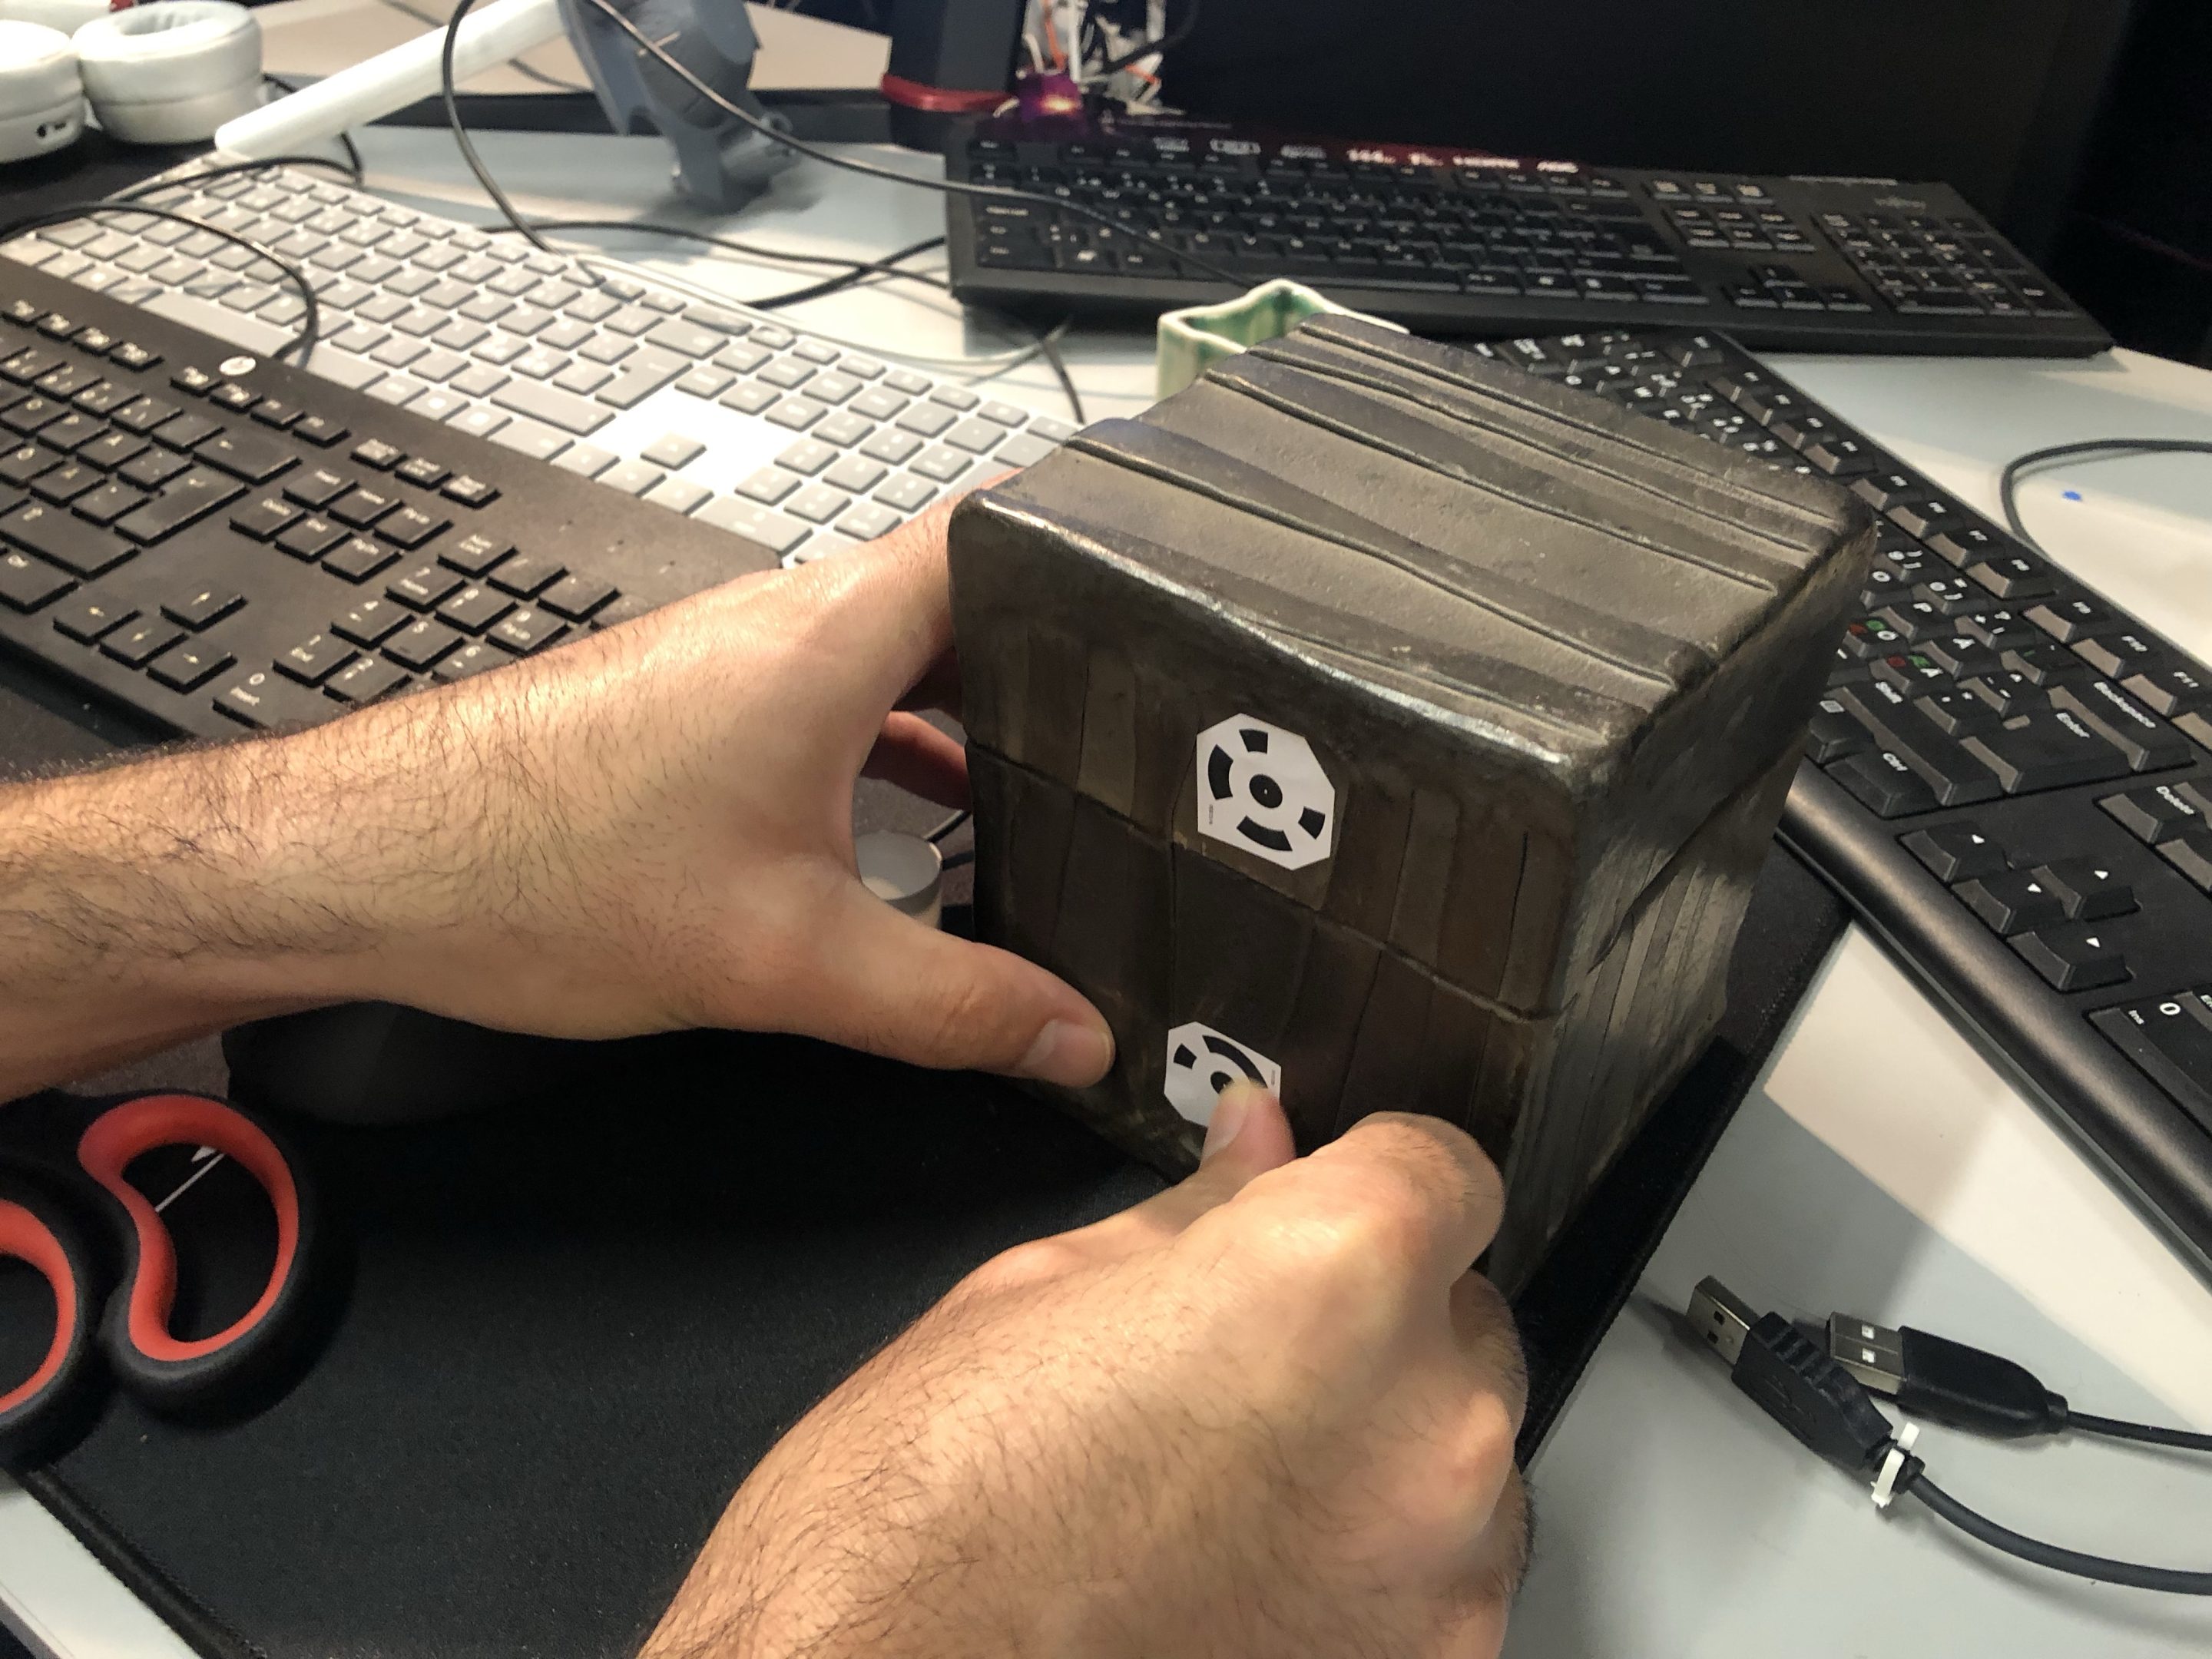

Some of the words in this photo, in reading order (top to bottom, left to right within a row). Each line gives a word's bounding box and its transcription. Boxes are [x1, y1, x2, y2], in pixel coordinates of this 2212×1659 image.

[1913, 602, 1932, 613] P
[2093, 681, 2156, 728] Backspace
[2055, 712, 2091, 738] Enter
[1883, 753, 1908, 771] Ctrl
[2155, 786, 2194, 815] Delete
[2128, 1009, 2144, 1025] Ins
[2159, 1002, 2181, 1015] 0
